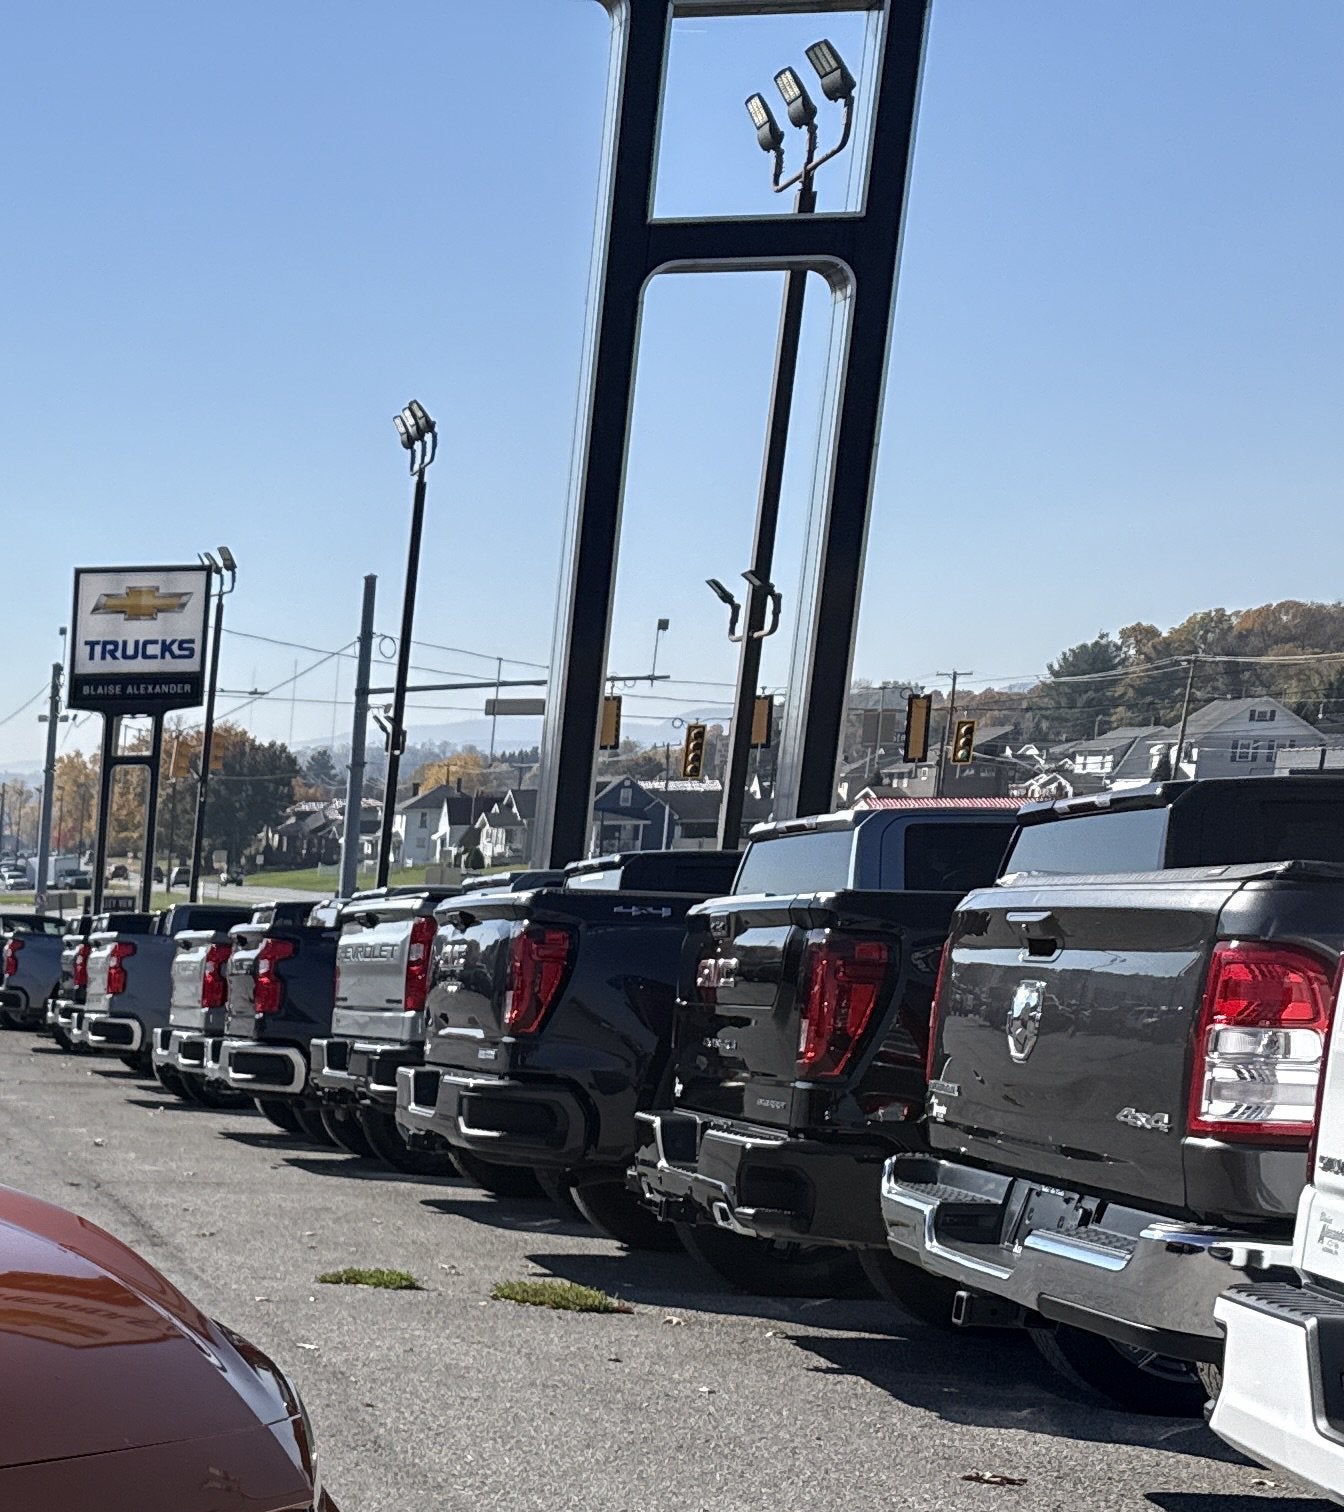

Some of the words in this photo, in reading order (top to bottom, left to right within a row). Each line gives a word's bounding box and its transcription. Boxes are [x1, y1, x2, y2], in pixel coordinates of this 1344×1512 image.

[84, 639, 195, 660] TRUCKS
[82, 685, 122, 695] BLAISE
[126, 684, 191, 694] ALEXANDER
